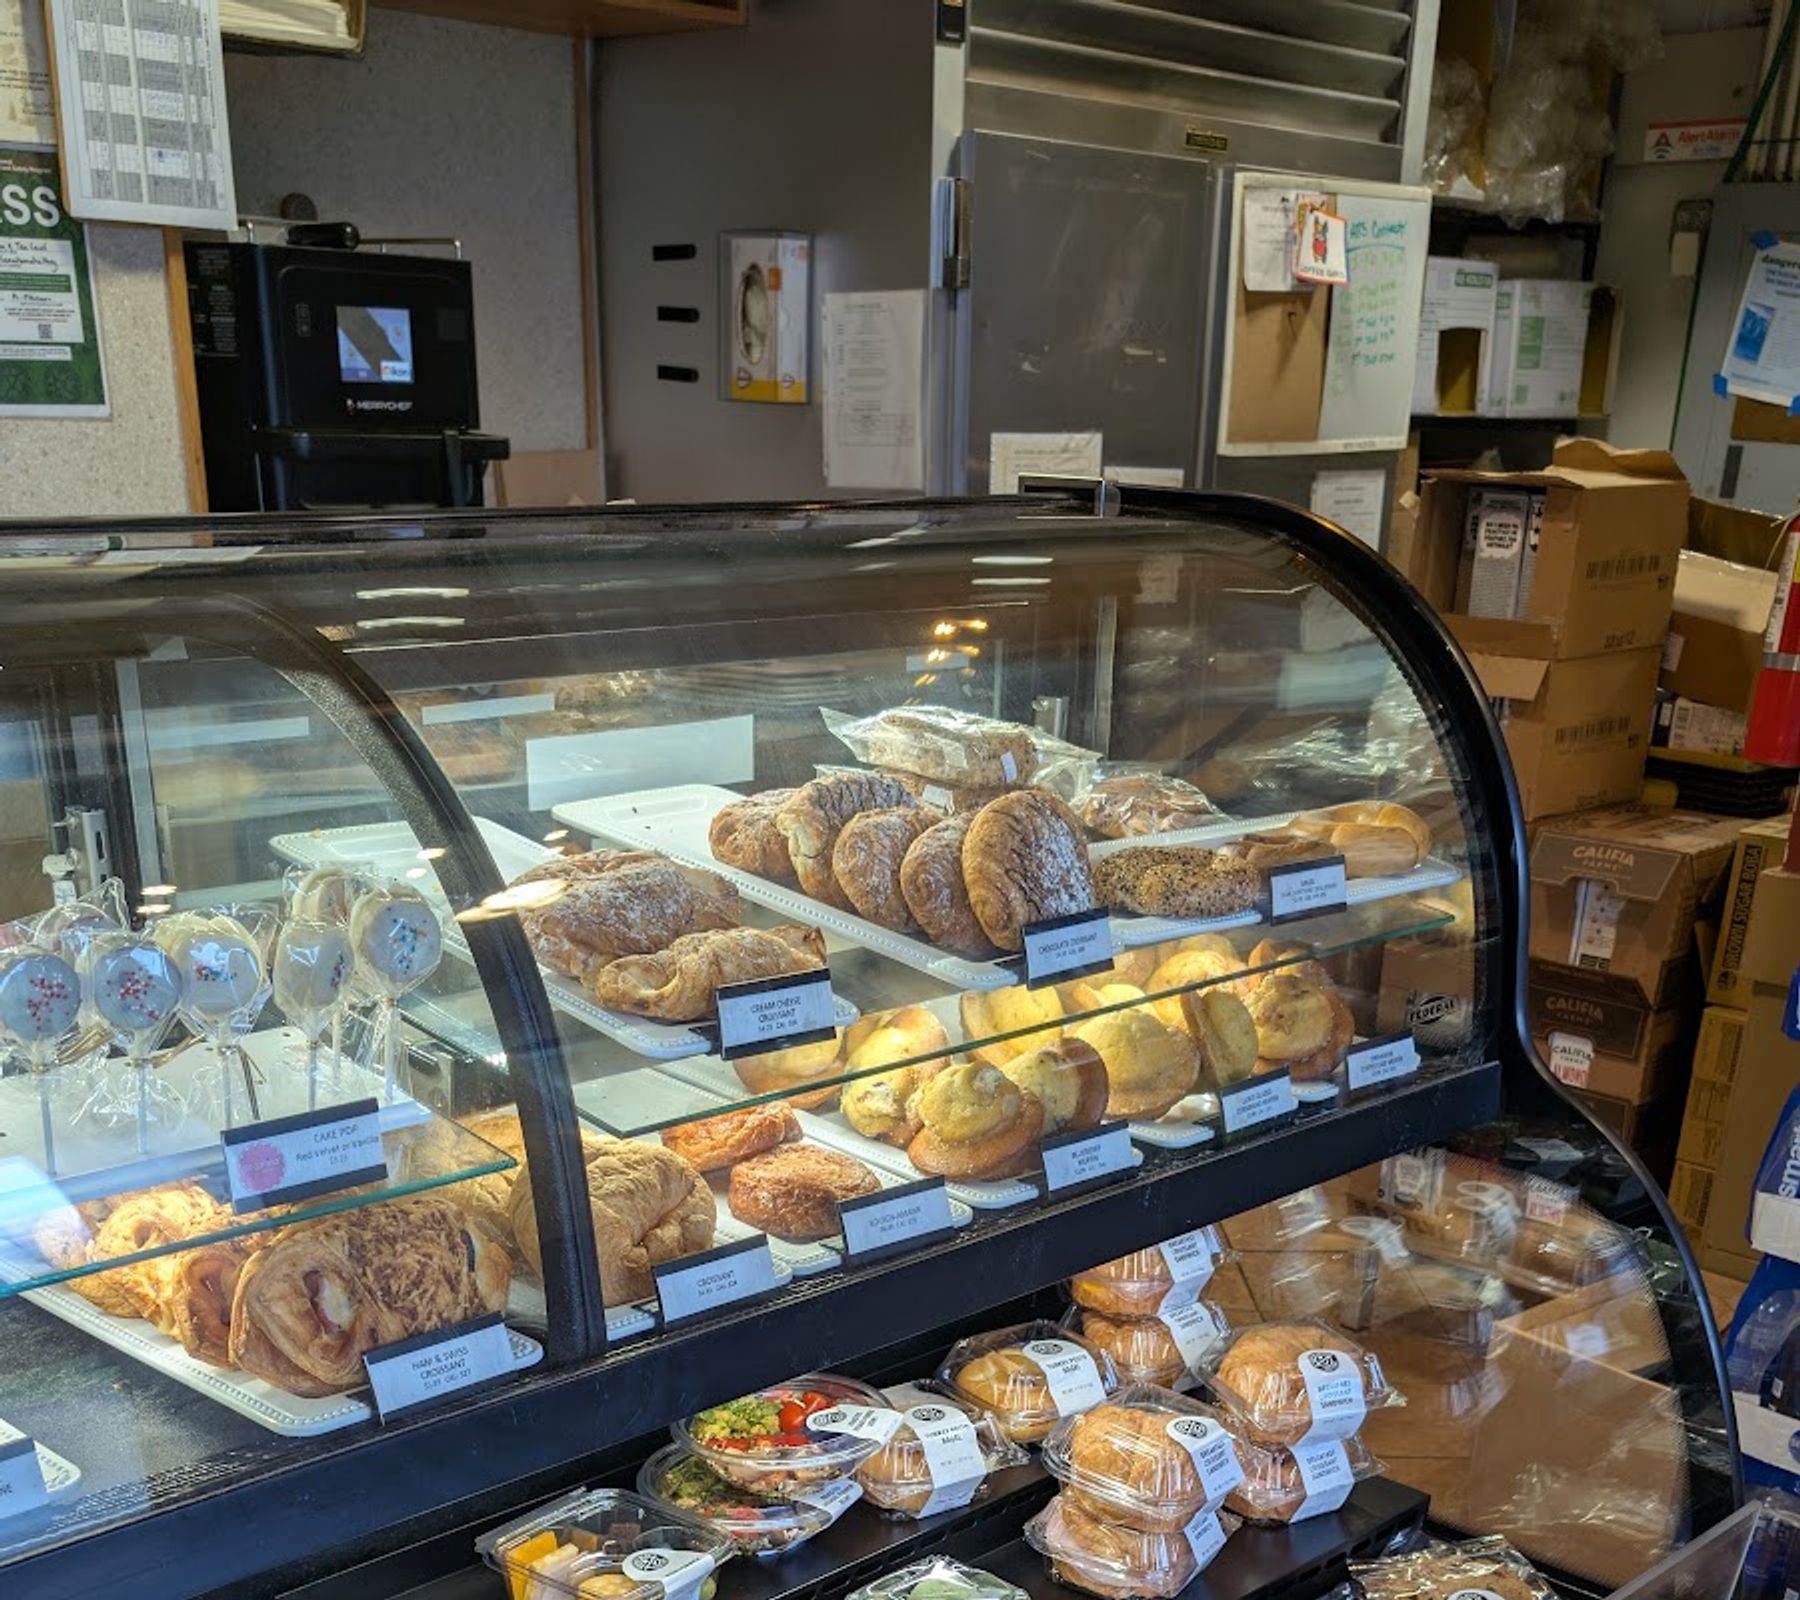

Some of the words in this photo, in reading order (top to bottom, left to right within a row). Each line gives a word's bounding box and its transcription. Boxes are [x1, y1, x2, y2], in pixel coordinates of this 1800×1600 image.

[1572, 845, 1635, 868] CALIFIA
[1734, 881, 1755, 922] SUGAR
[1725, 924, 1746, 970] BROWN
[1545, 995, 1604, 1021] CALIFIA
[314, 1129, 337, 1144] CAKE
[412, 1359, 434, 1371] HAM
[443, 1346, 470, 1360] SWISS
[420, 1358, 467, 1380] CROISSANT
